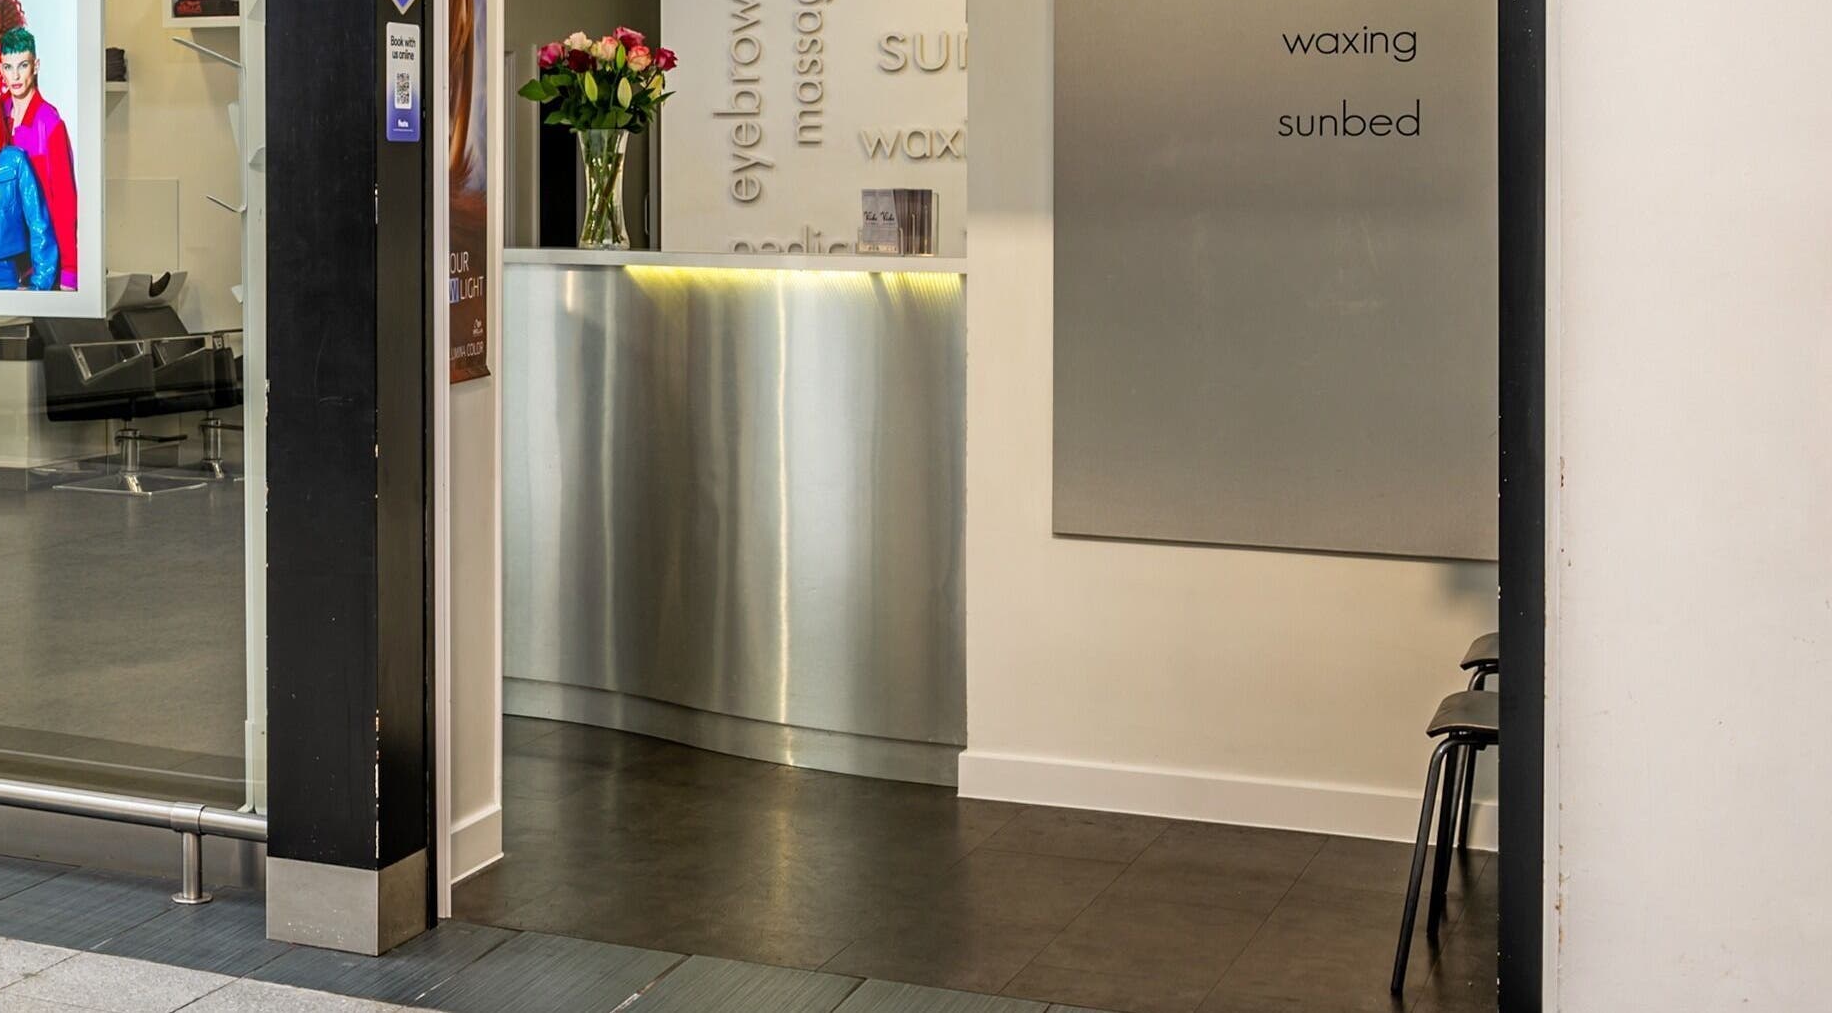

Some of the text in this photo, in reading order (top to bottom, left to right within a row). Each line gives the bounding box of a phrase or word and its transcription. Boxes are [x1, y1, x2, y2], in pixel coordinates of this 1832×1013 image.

[1283, 25, 1418, 62] waxing
[1278, 99, 1421, 137] sunbed
[460, 276, 484, 300] LIGHT
